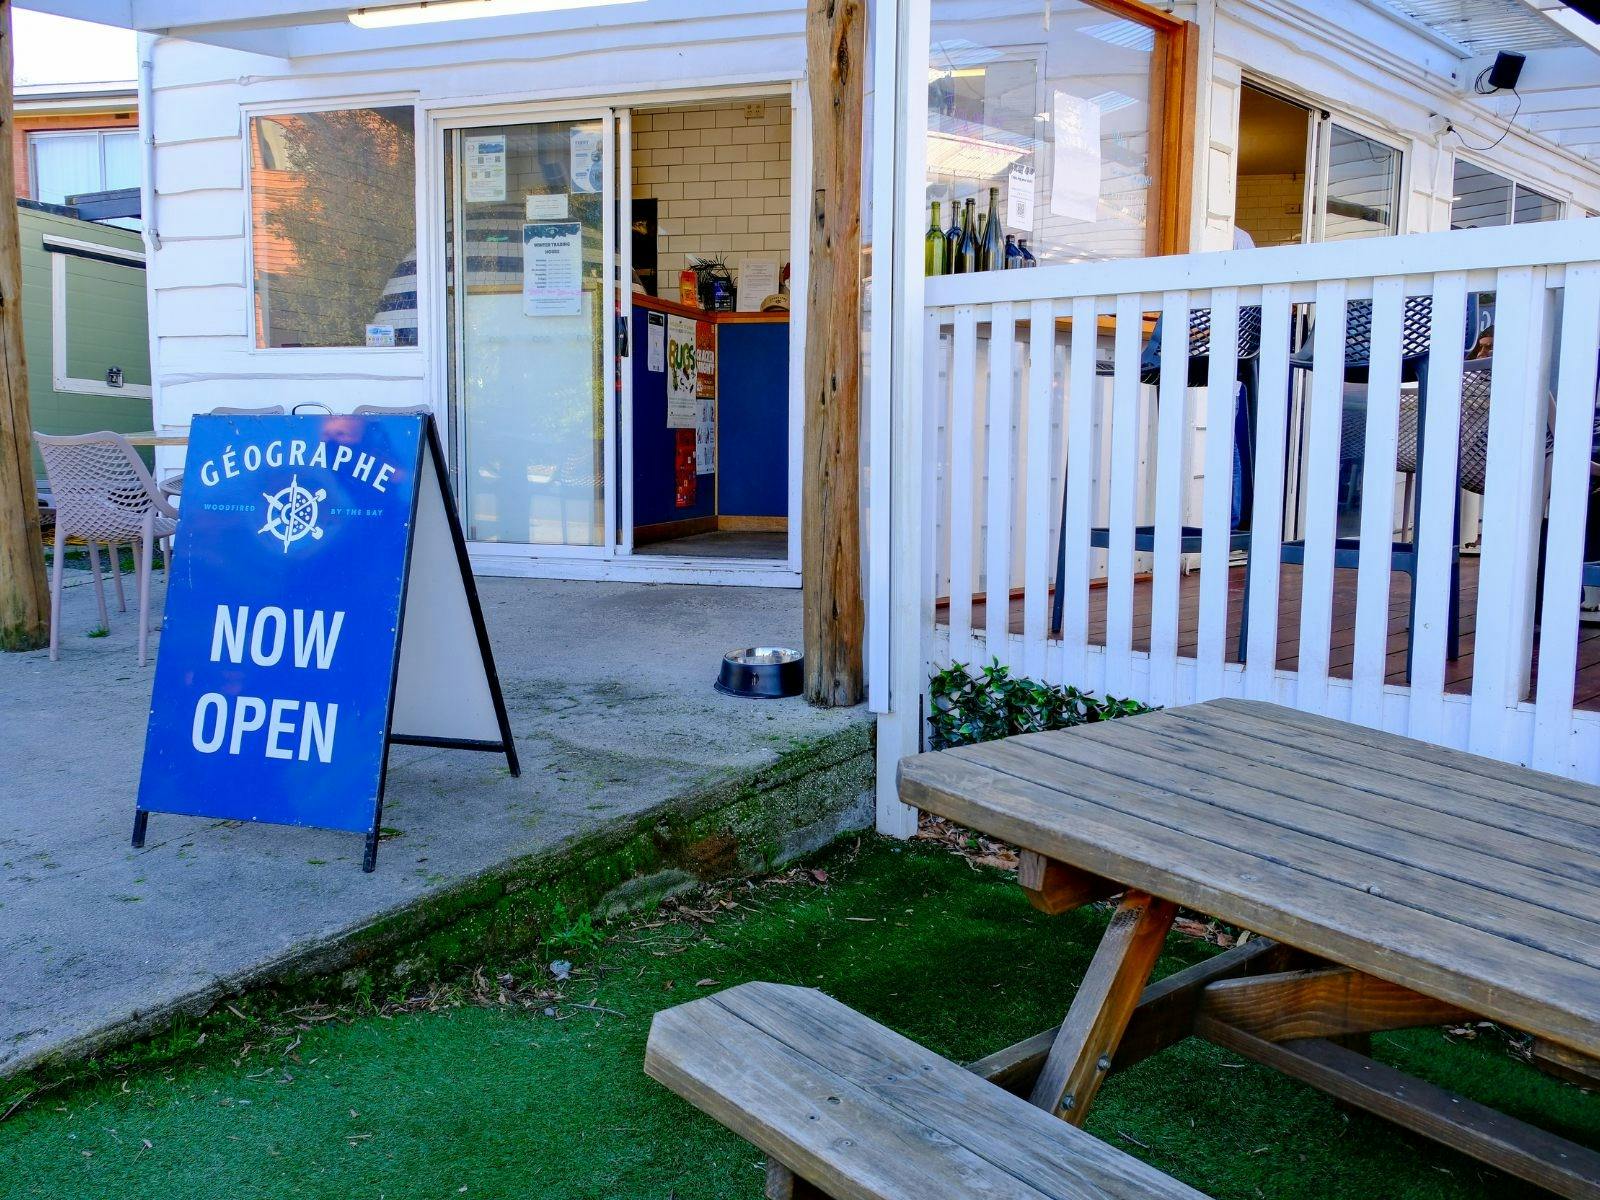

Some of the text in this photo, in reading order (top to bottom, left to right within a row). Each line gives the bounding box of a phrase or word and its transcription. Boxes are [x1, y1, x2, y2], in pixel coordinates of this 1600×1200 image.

[668, 339, 696, 370] BUGS
[201, 440, 396, 493] GÉOGRAPHE
[204, 503, 256, 513] WOODFIRED
[346, 508, 362, 516] THE
[210, 604, 346, 670] NOW
[192, 692, 339, 764] OPEN
